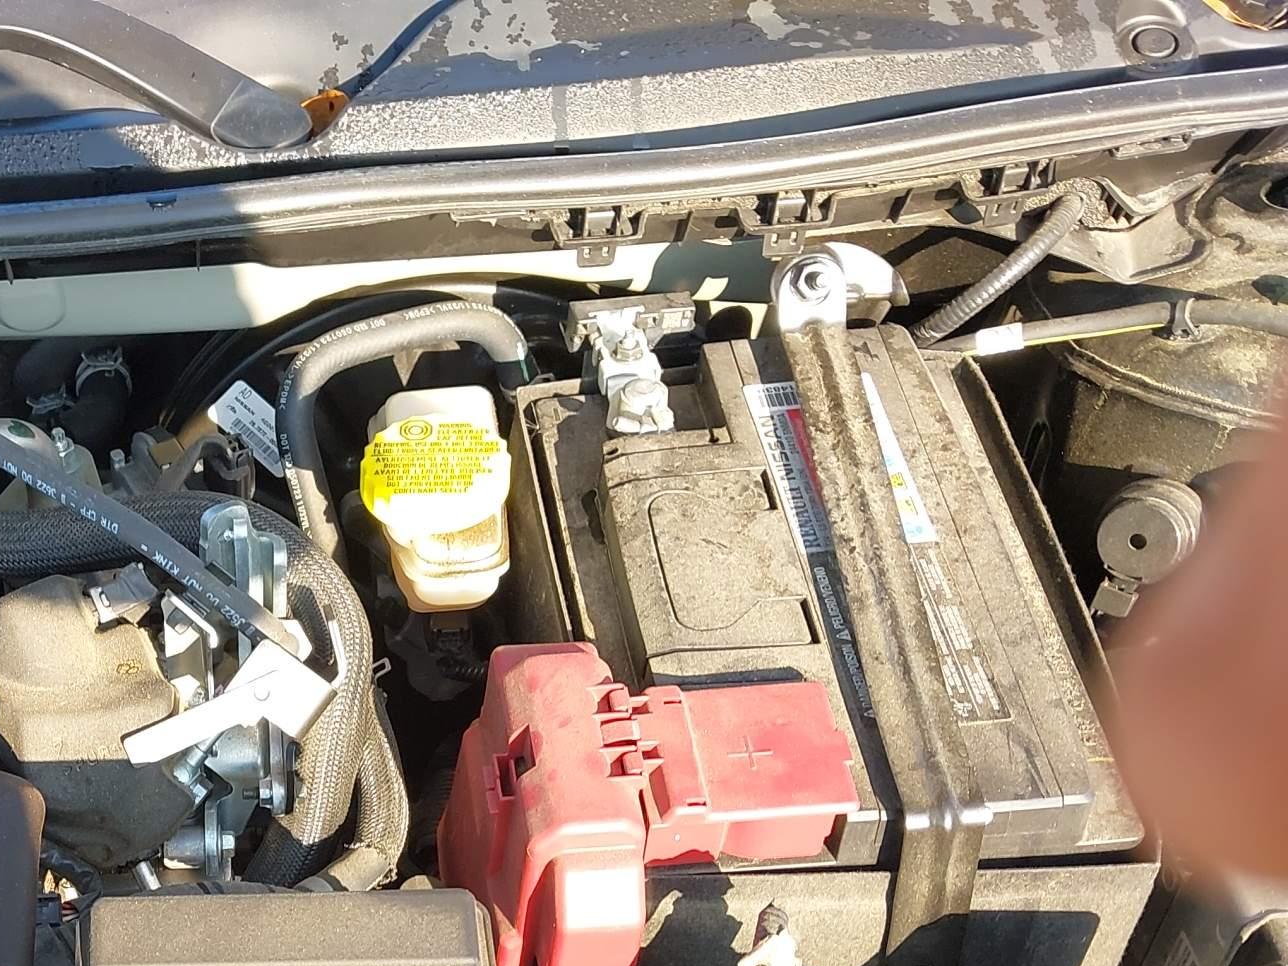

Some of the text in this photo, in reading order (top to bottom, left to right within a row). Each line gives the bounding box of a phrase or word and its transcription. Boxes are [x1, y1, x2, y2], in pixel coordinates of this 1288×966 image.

[279, 433, 290, 450] DOT
[3, 461, 18, 476] NOT
[21, 470, 33, 485] DO
[36, 479, 57, 500] 3622
[80, 506, 97, 522] CFP
[783, 483, 821, 549] RENAULT
[101, 515, 119, 535] DTR
[153, 551, 180, 576] KINK
